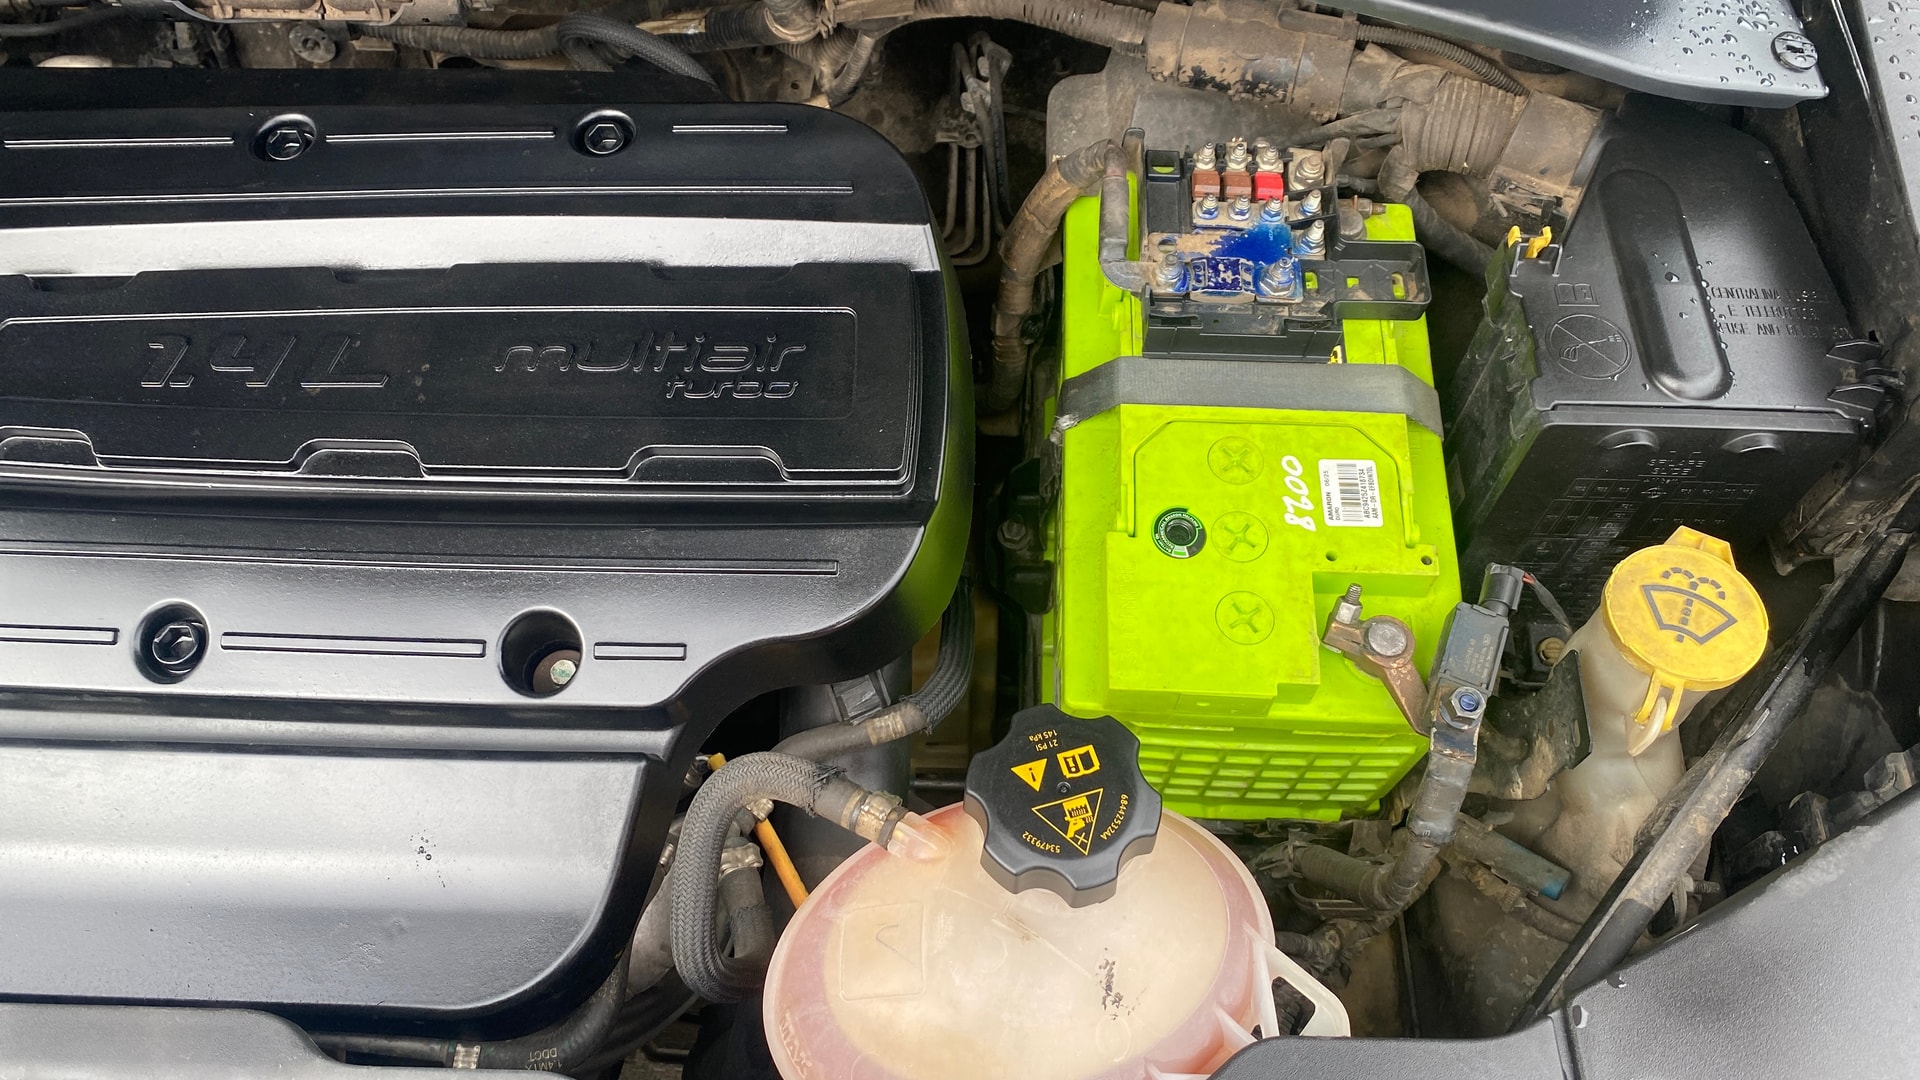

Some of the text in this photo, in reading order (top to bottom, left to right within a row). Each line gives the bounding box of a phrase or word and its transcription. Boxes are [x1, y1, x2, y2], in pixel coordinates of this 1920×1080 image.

[494, 331, 807, 372] multiair
[667, 376, 800, 399] turbo
[1325, 492, 1334, 520] AMARON
[1028, 729, 1058, 742] 145 kPa
[1035, 739, 1059, 751] 21 PSI
[1022, 830, 1061, 854] 53479332
[528, 1047, 558, 1062] DDCT
